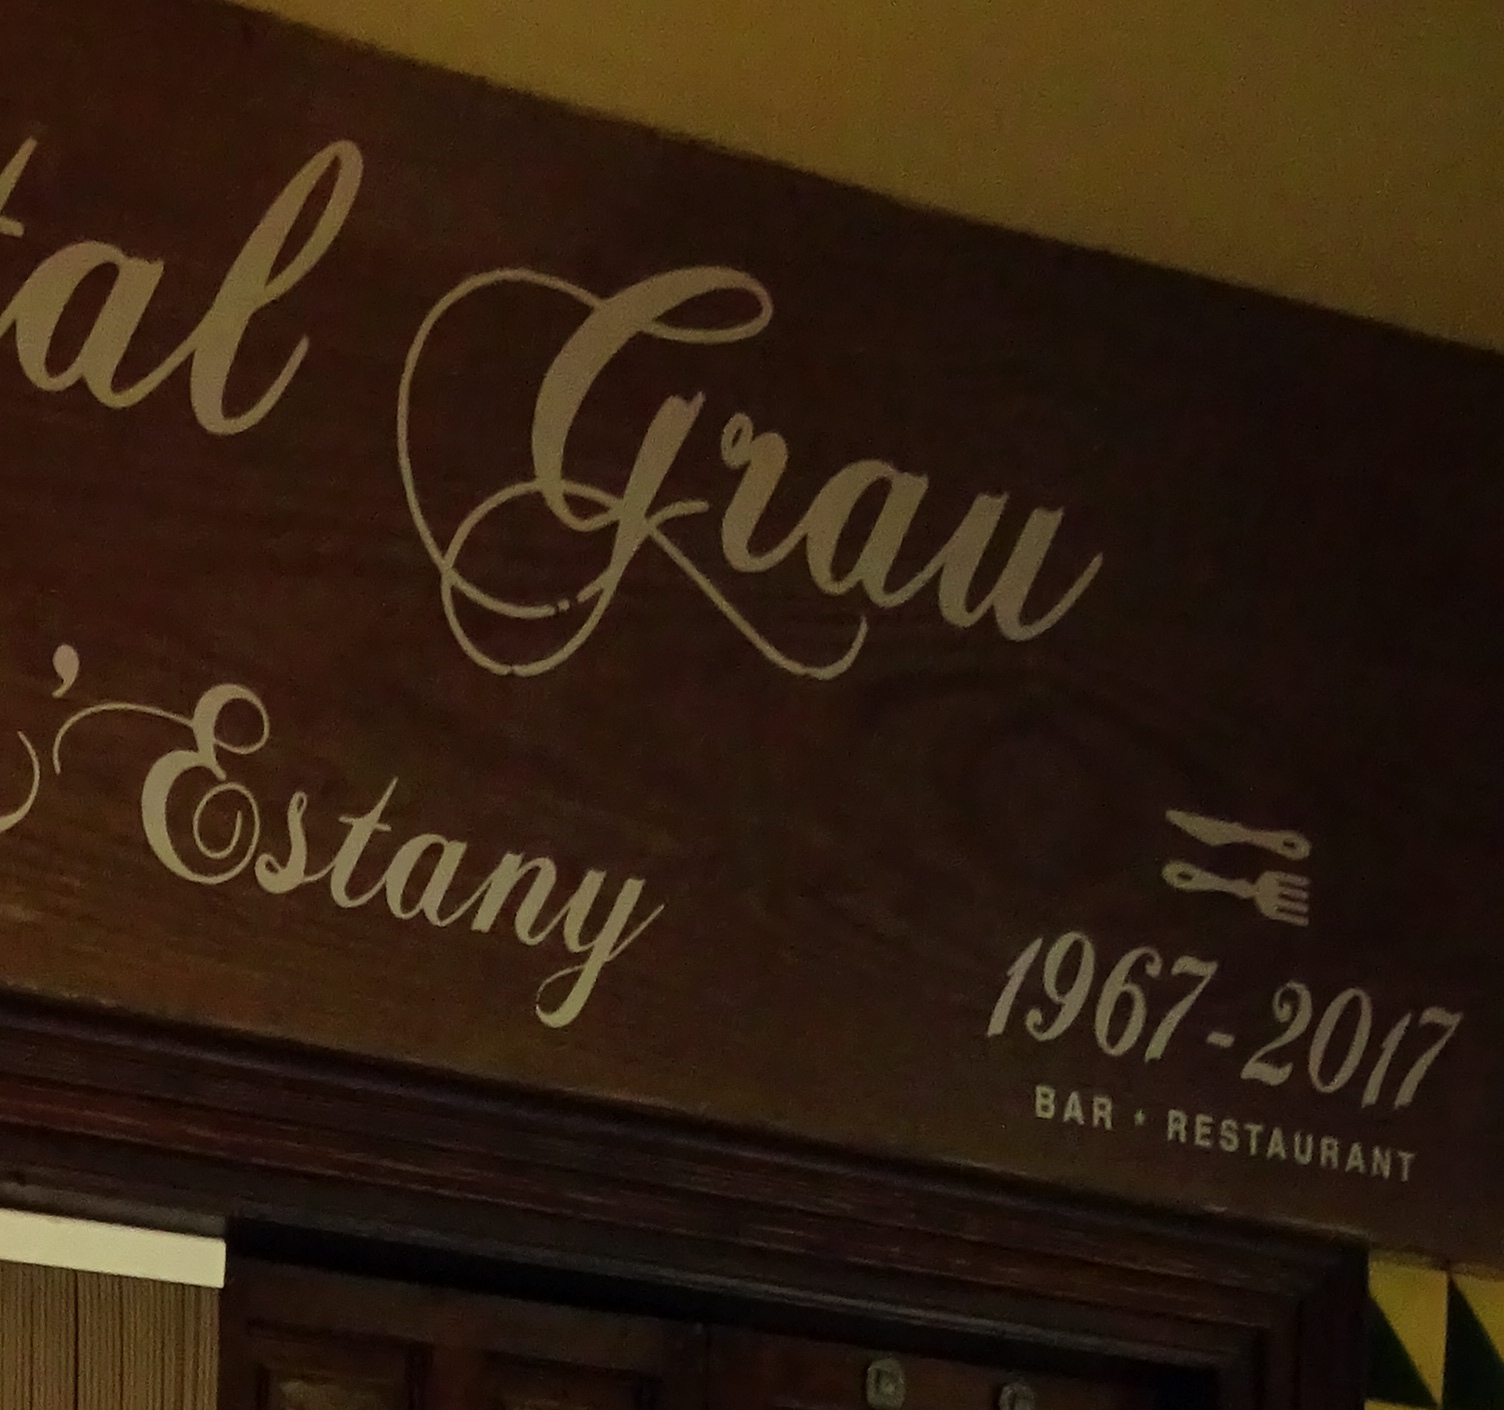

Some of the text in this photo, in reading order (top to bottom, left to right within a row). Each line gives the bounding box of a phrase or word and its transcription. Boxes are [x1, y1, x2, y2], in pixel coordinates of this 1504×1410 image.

[398, 266, 1102, 680] Grau
[987, 931, 1464, 1110] 1967-2017
[1034, 1085, 1416, 1182] BAR RESTAURANT
